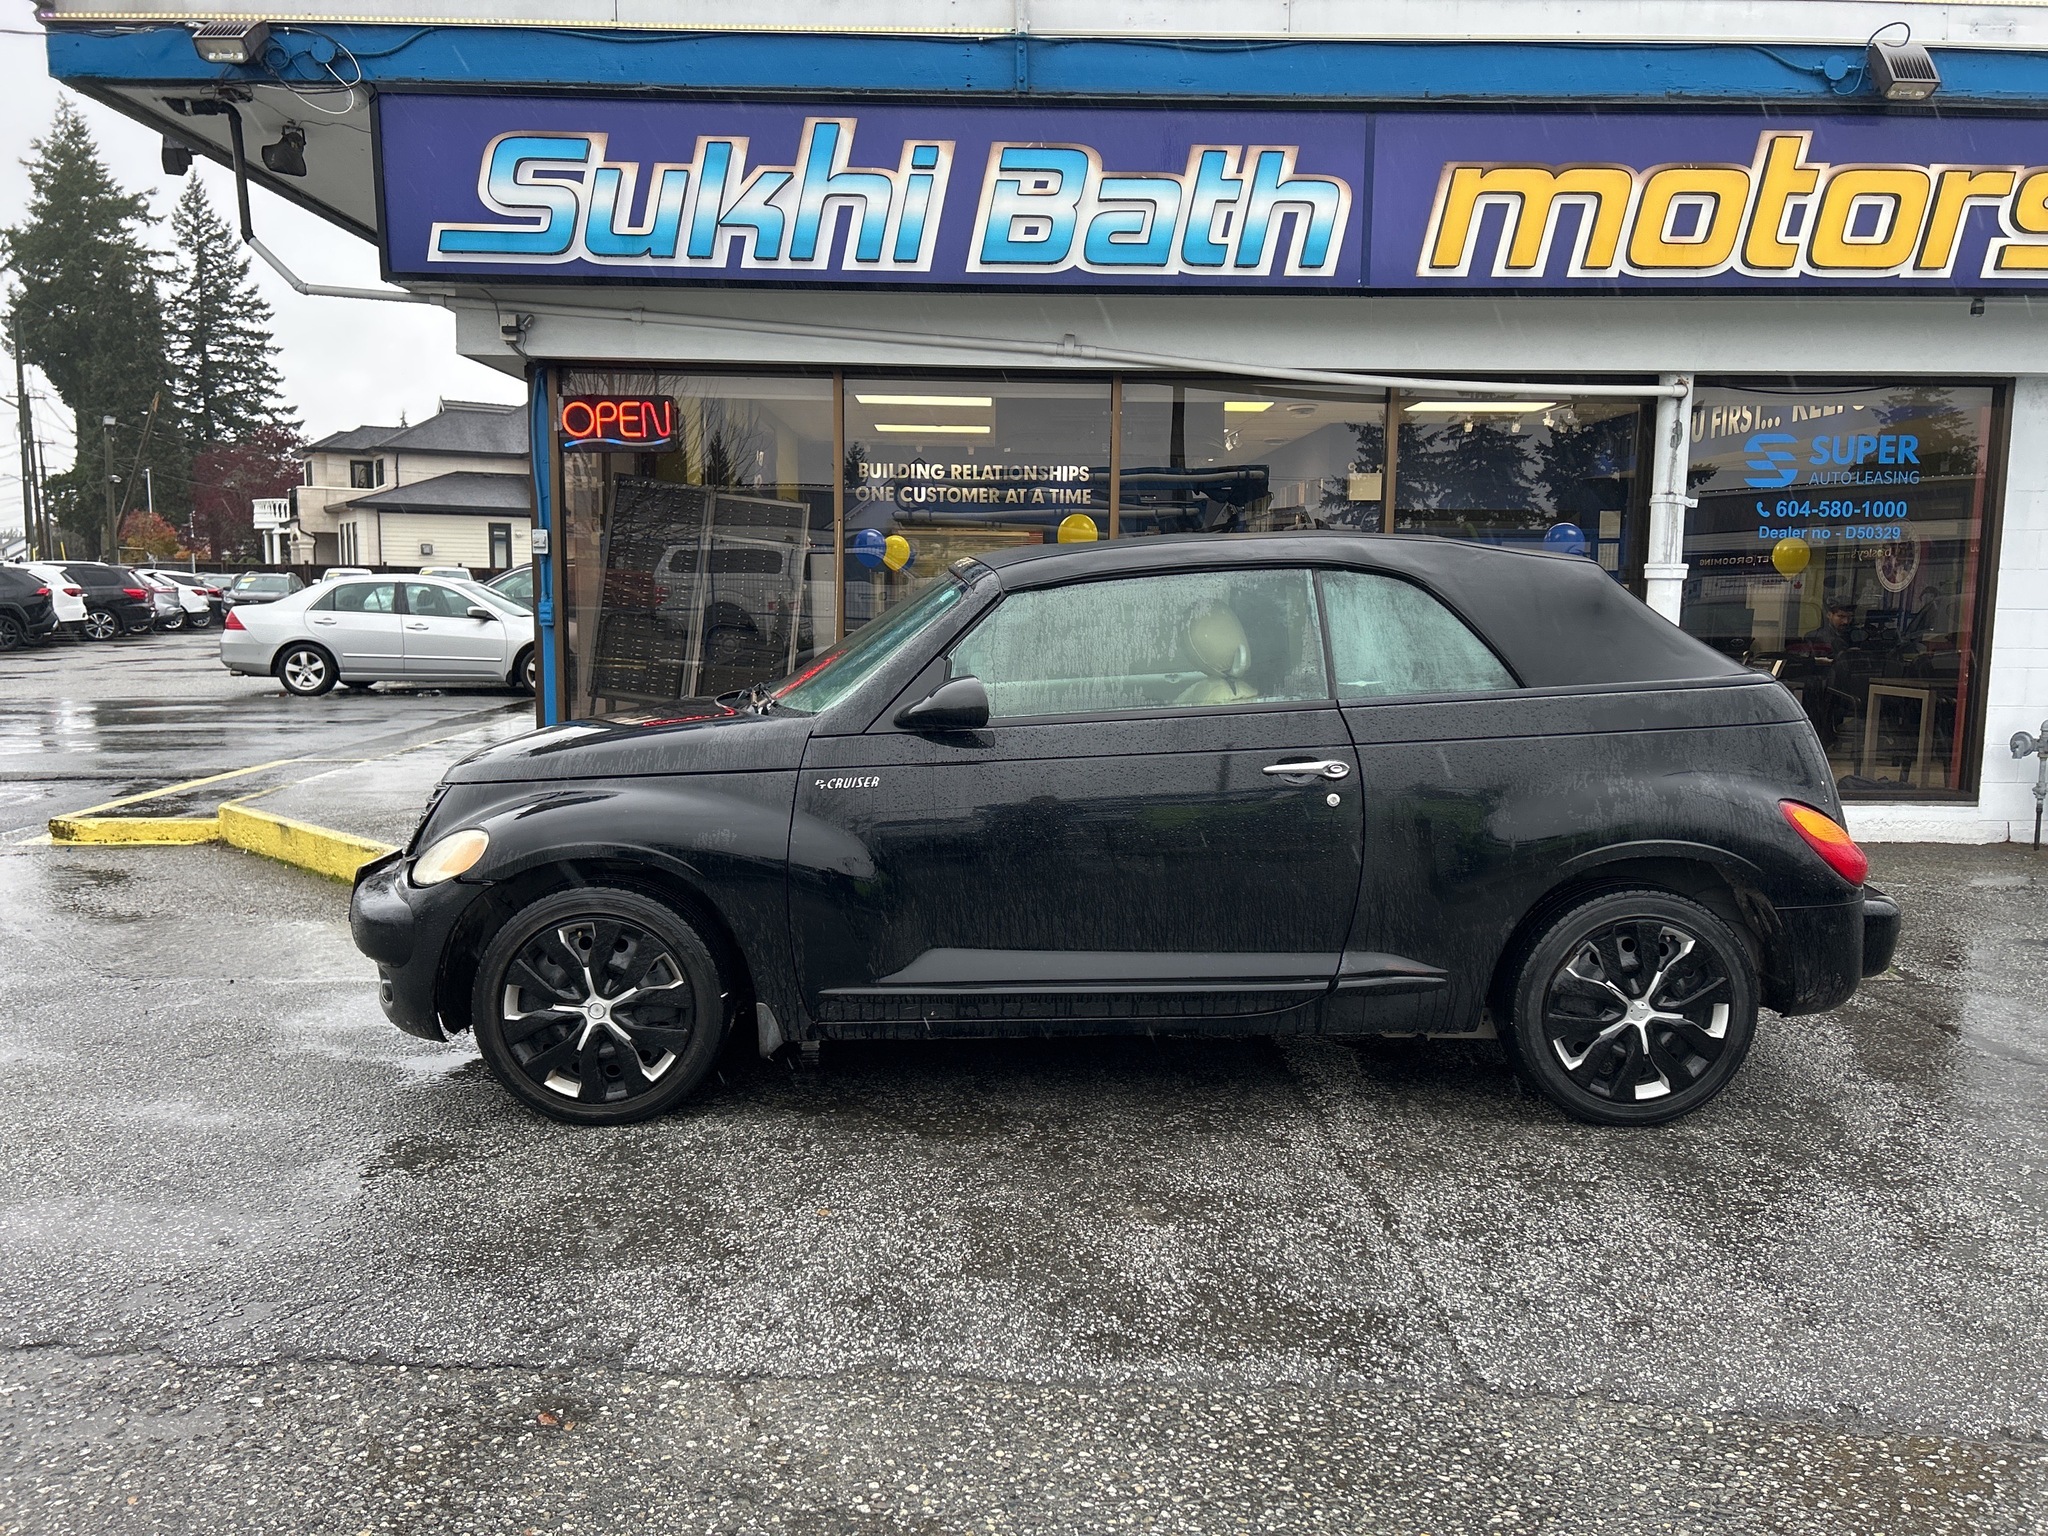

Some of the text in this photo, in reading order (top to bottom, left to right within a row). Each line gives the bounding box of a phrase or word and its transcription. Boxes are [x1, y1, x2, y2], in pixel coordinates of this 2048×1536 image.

[428, 117, 956, 272] Sukhi
[966, 142, 1352, 277] Bath
[562, 401, 671, 438] OPEN
[1809, 435, 1920, 465] SUPER
[858, 462, 1090, 482] BUILDING RELATIONSHIPS
[1809, 470, 1920, 485] AUTO LEASING
[856, 486, 1092, 505] ONE CUSTOMER AT A TIME
[1776, 501, 1908, 518] 604-580-1000
[1759, 526, 1808, 539] Dealer
[1812, 528, 1831, 539] no
[1845, 526, 1902, 539] D50329
[827, 776, 880, 789] CRUISER
